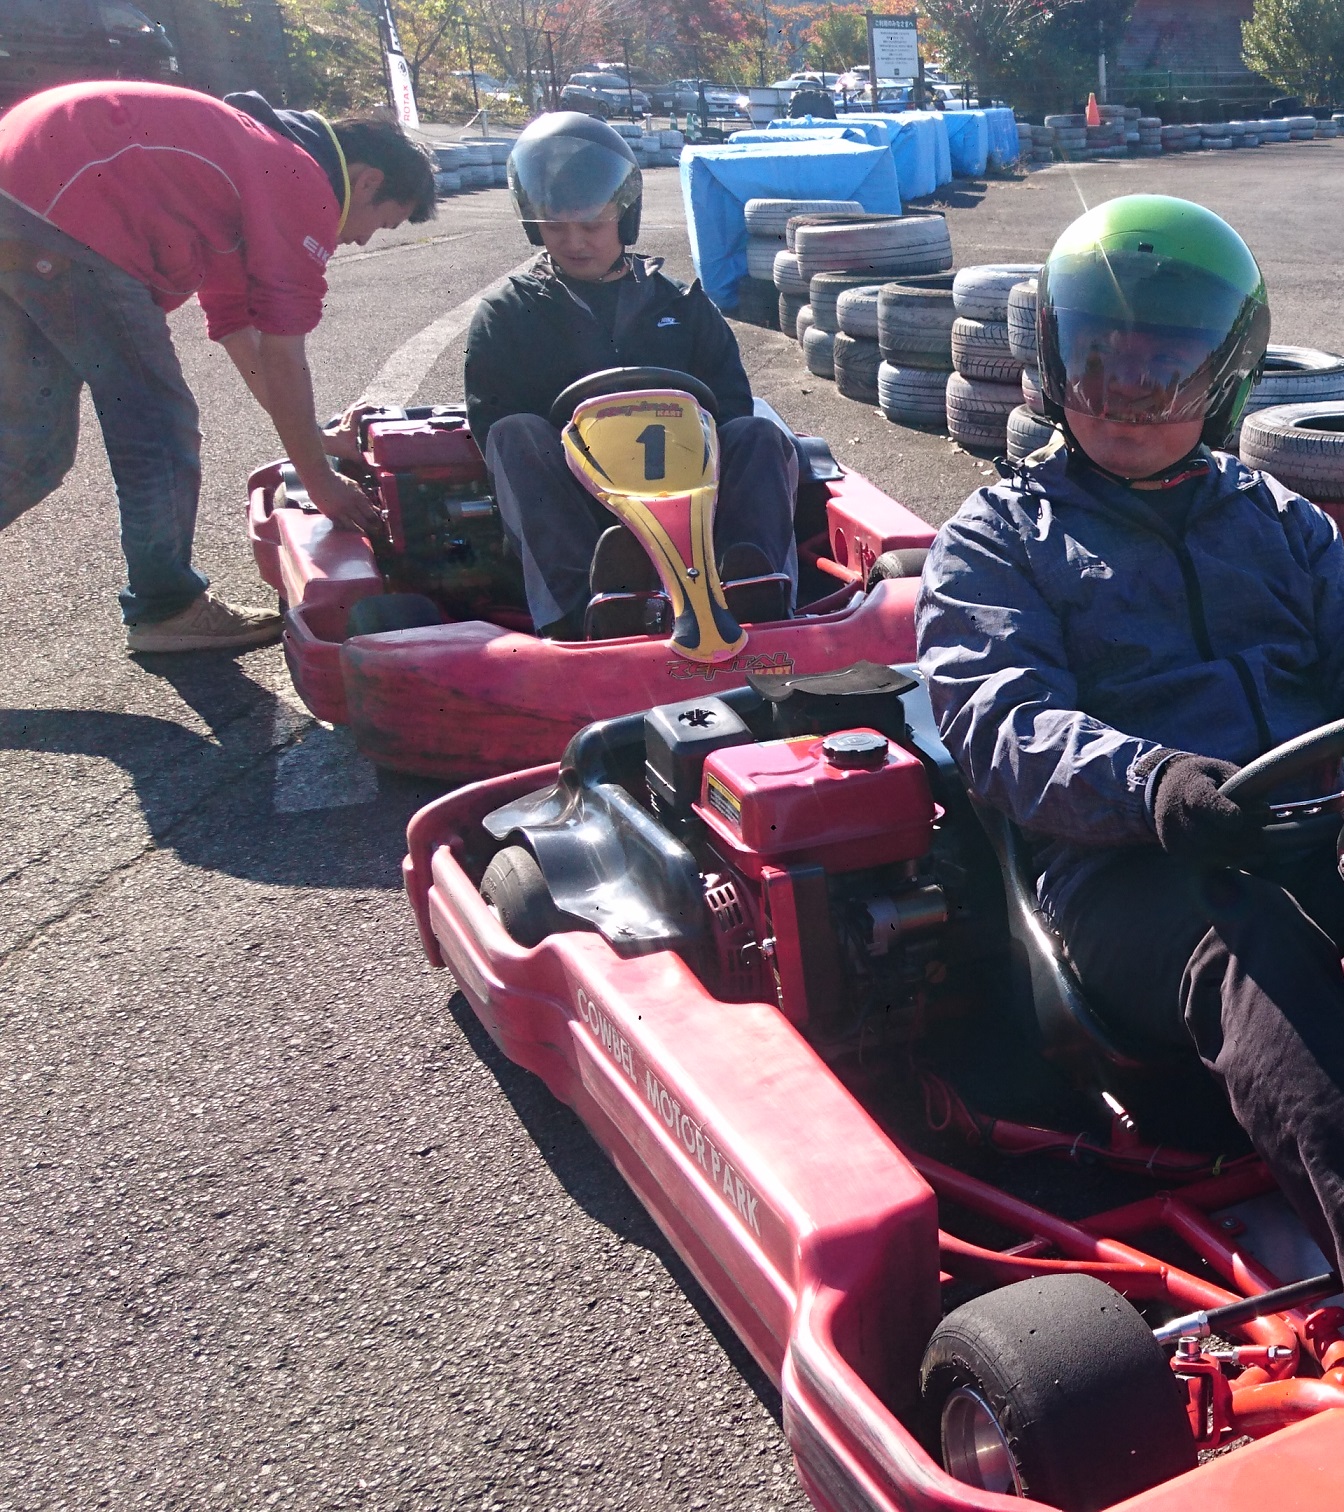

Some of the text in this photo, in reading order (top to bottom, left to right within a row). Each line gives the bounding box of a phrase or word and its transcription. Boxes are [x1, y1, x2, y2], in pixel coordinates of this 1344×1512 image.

[403, 85, 411, 122] ROTAX
[635, 424, 666, 481] 1
[576, 988, 761, 1237] COWBEL MOTOR PARK
